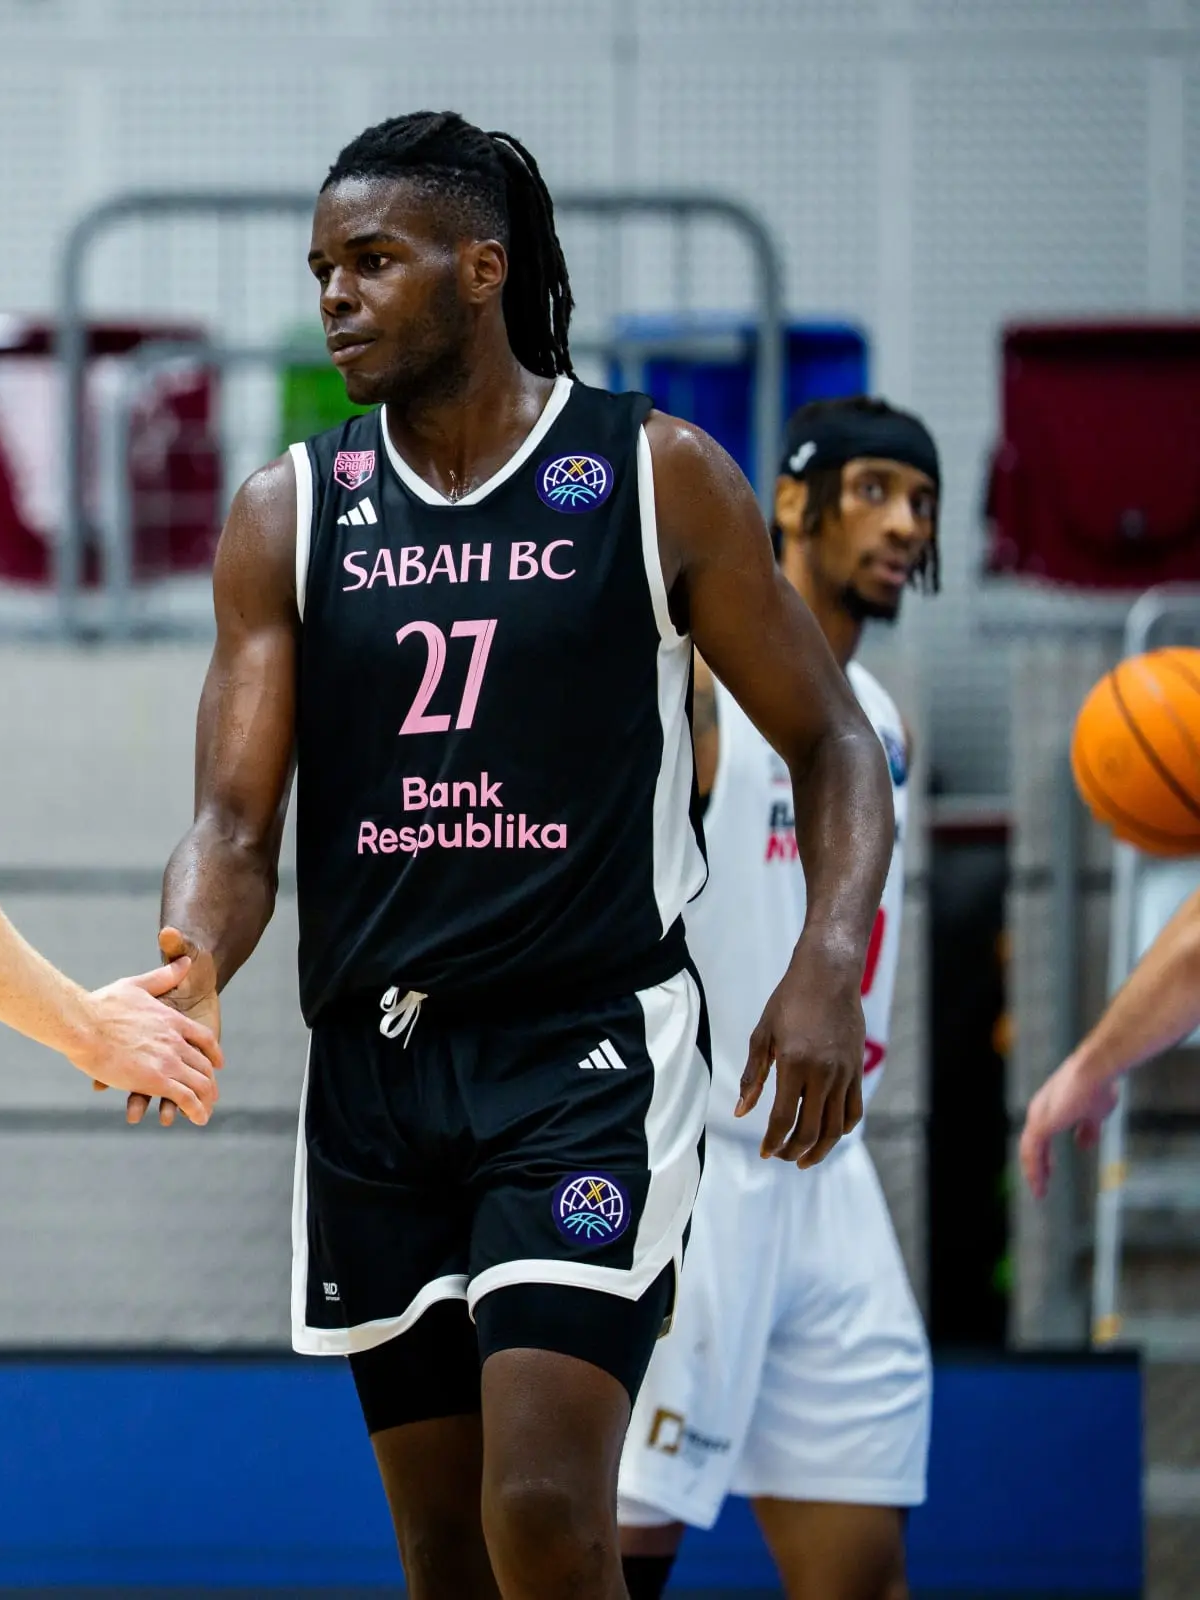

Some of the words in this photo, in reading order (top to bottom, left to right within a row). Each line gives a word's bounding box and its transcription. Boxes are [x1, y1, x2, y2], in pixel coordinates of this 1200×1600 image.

[336, 459, 373, 471] SABAH
[342, 542, 491, 592] SABAH
[508, 539, 576, 581] BC
[395, 618, 498, 736] 27
[402, 771, 504, 812] Bank
[357, 812, 568, 858] Respublika
